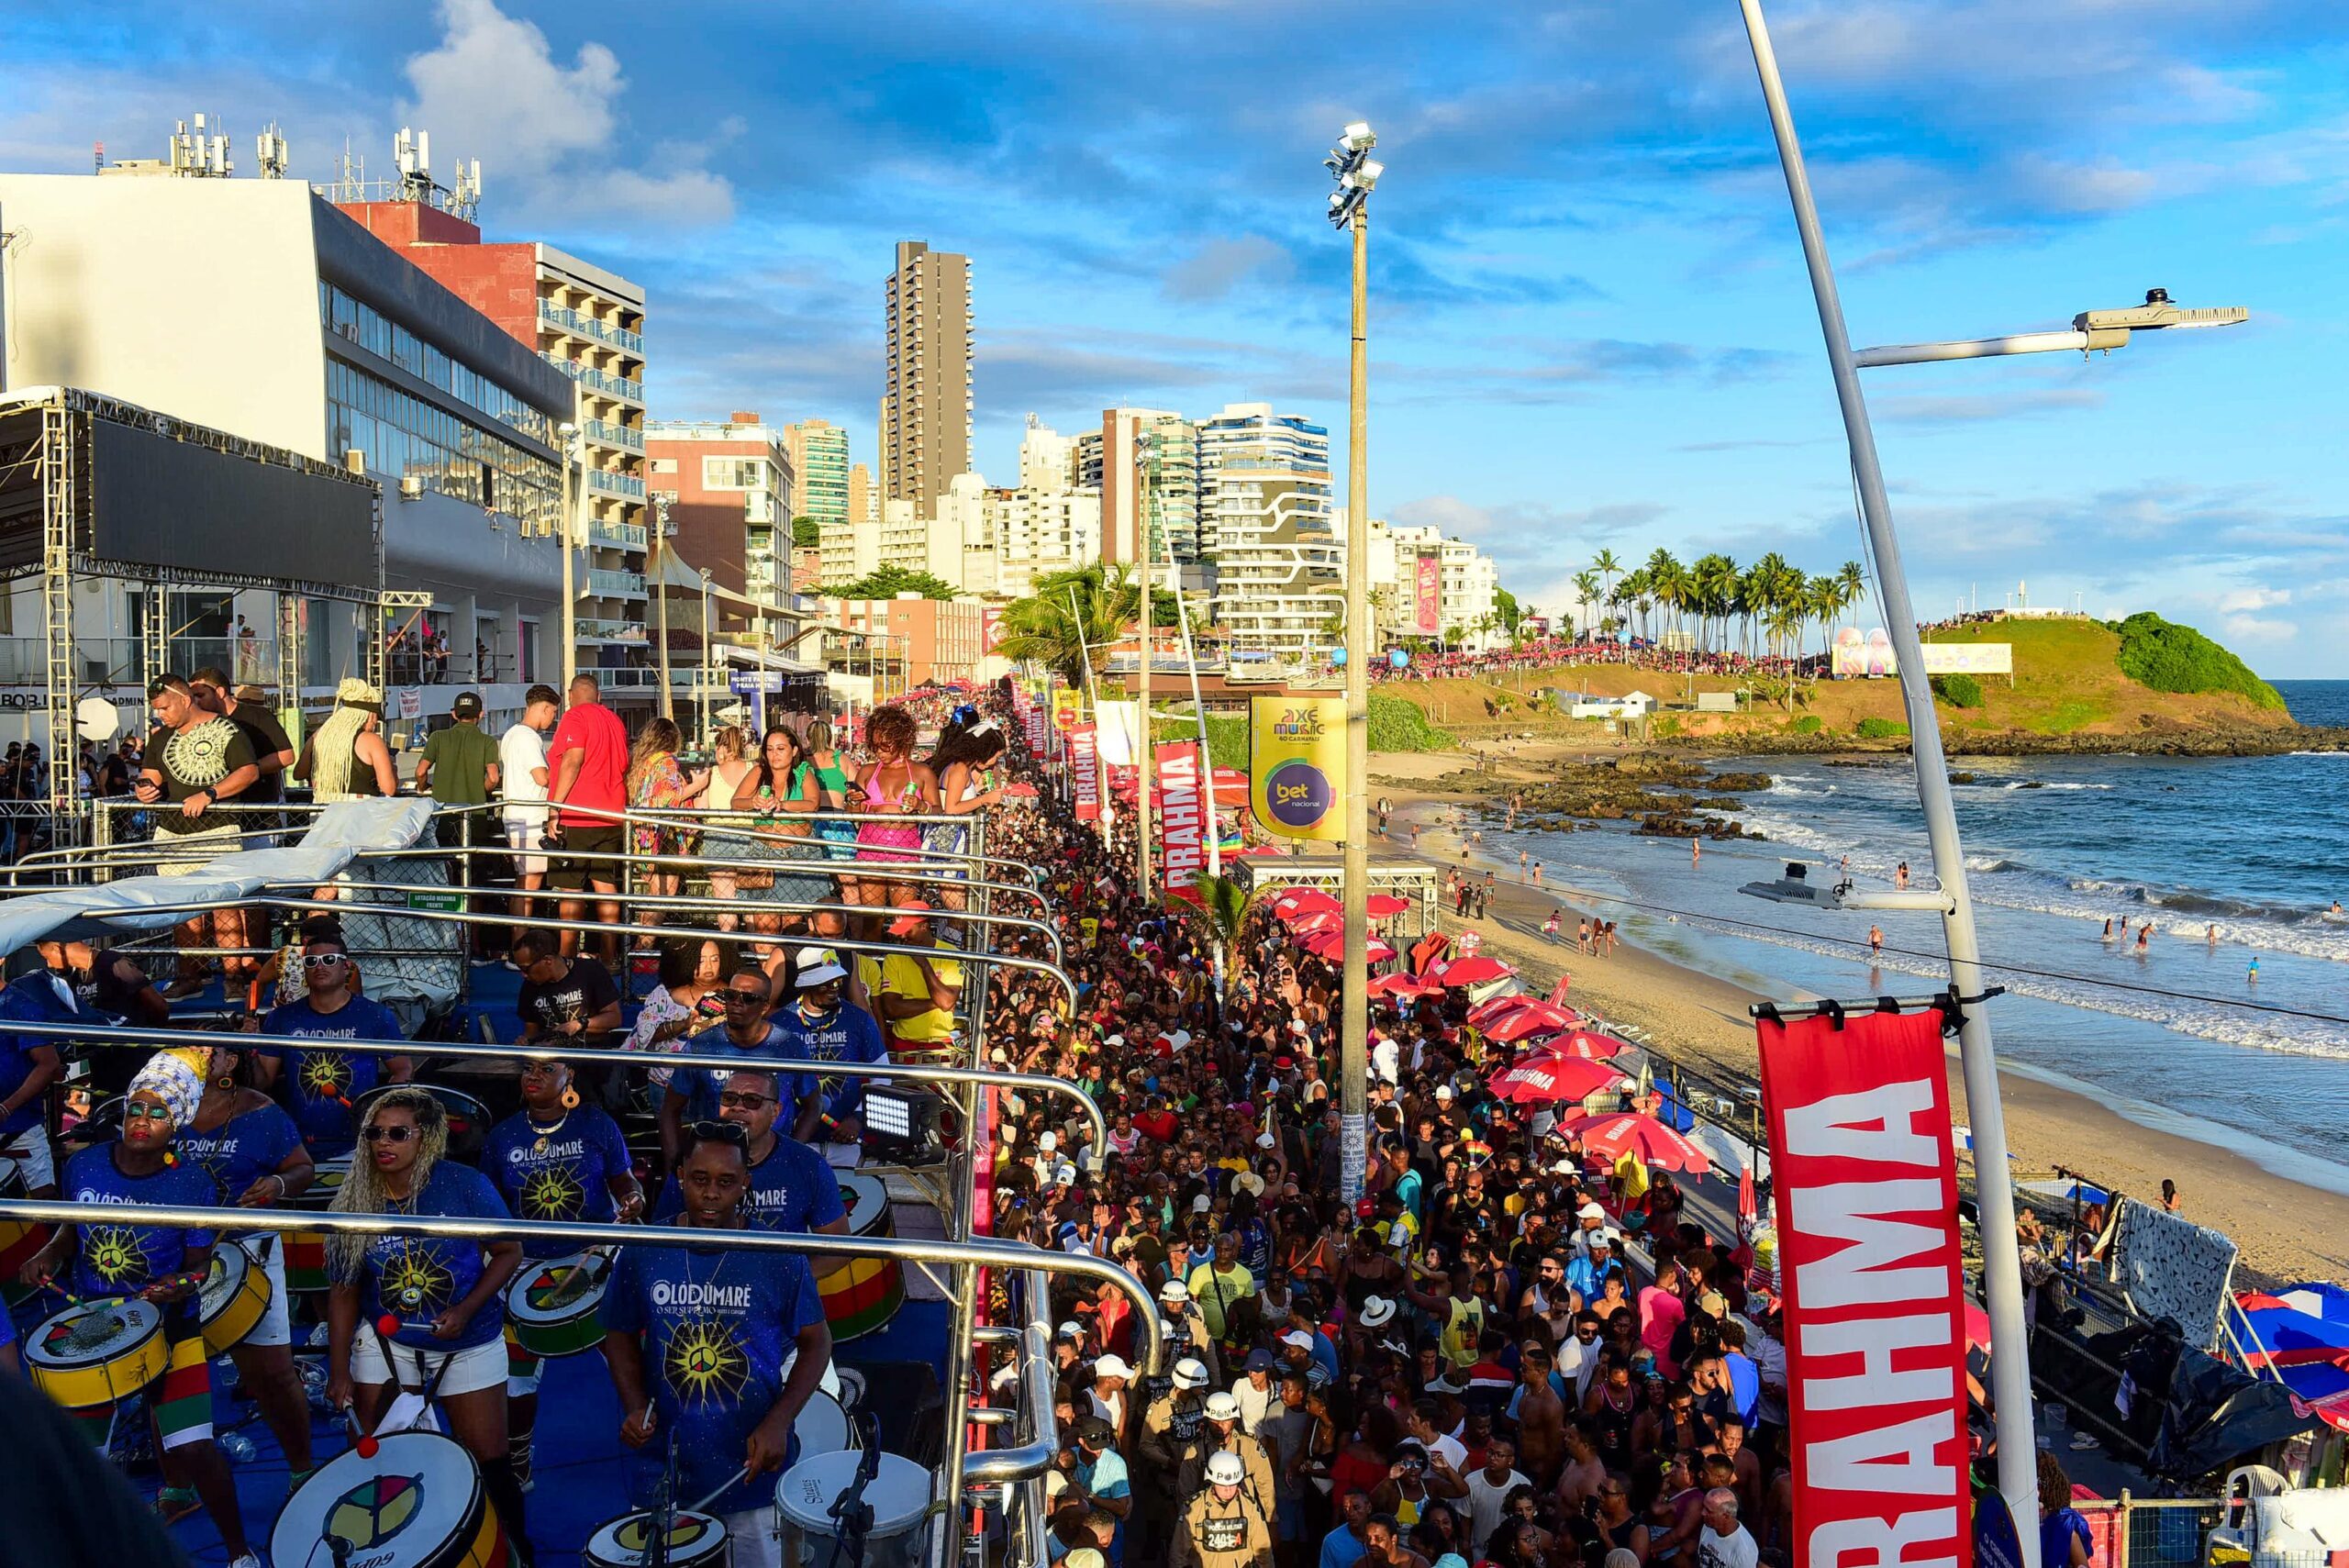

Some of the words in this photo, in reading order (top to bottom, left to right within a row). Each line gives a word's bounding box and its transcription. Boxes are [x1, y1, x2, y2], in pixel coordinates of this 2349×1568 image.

[1074, 729, 1097, 806] BRAHMA
[1276, 783, 1308, 805] bet
[1291, 800, 1320, 808] nacional
[1160, 754, 1202, 888] BRAHMA
[1504, 1067, 1556, 1091] BRAHMA
[1605, 1118, 1638, 1141] BRAHMA
[656, 1307, 663, 1315] O
[663, 1307, 683, 1317] SER
[679, 1307, 717, 1317] SUPREMO
